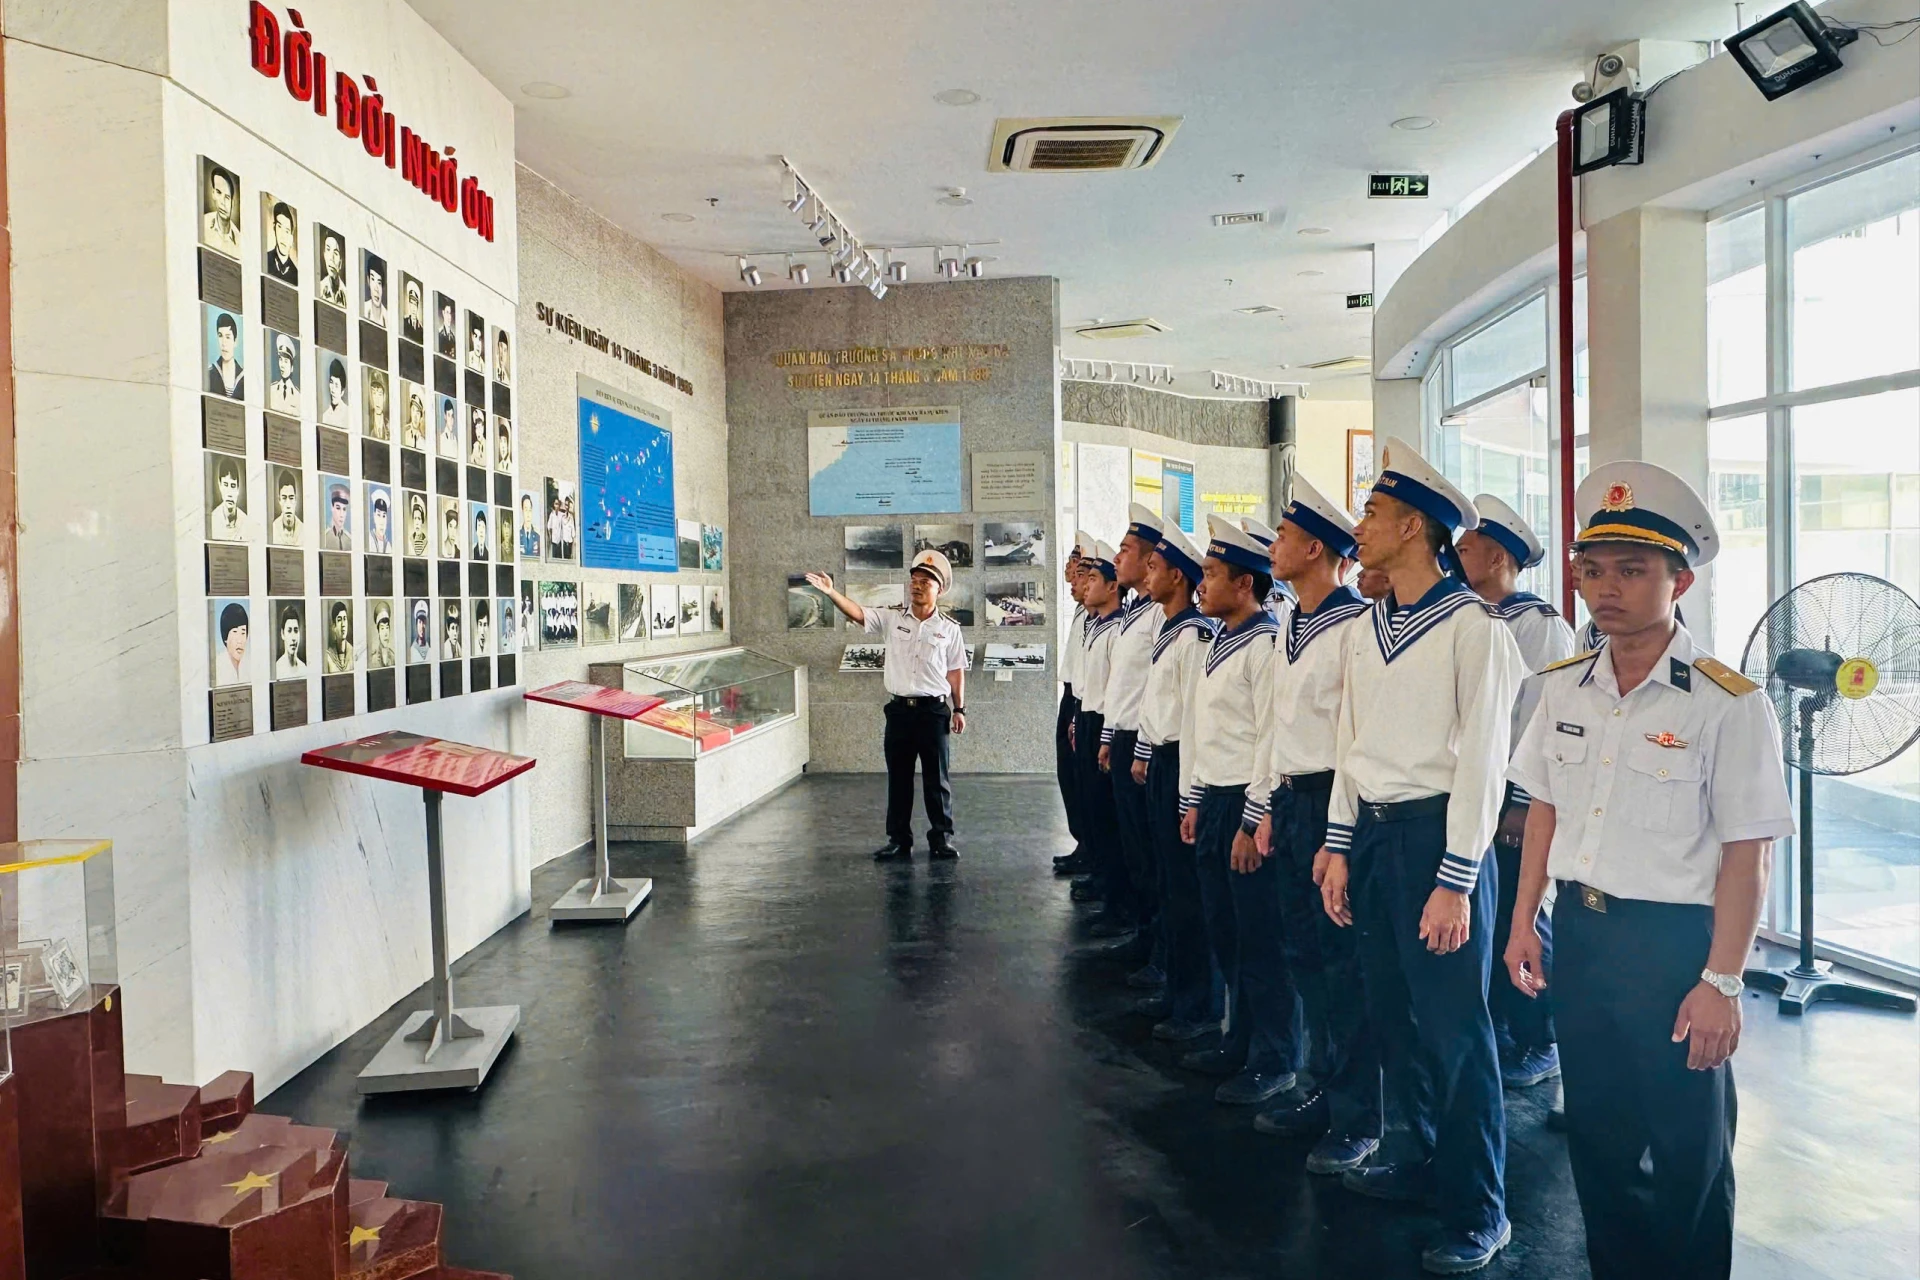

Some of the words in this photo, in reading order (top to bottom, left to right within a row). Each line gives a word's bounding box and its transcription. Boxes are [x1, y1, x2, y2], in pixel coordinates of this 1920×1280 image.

[249, 0, 327, 117] ĐỜI
[335, 71, 396, 170] ĐỜI
[401, 125, 458, 213] NHỚ
[461, 175, 494, 243] ƠN
[1373, 182, 1389, 190] EXIT
[536, 301, 555, 334] SỰ
[555, 312, 582, 345] KIỆN
[582, 327, 609, 354] NGÀY
[611, 341, 622, 361] 14
[622, 347, 652, 376] THÁNG
[652, 363, 659, 379] 3
[869, 372, 880, 385] 14
